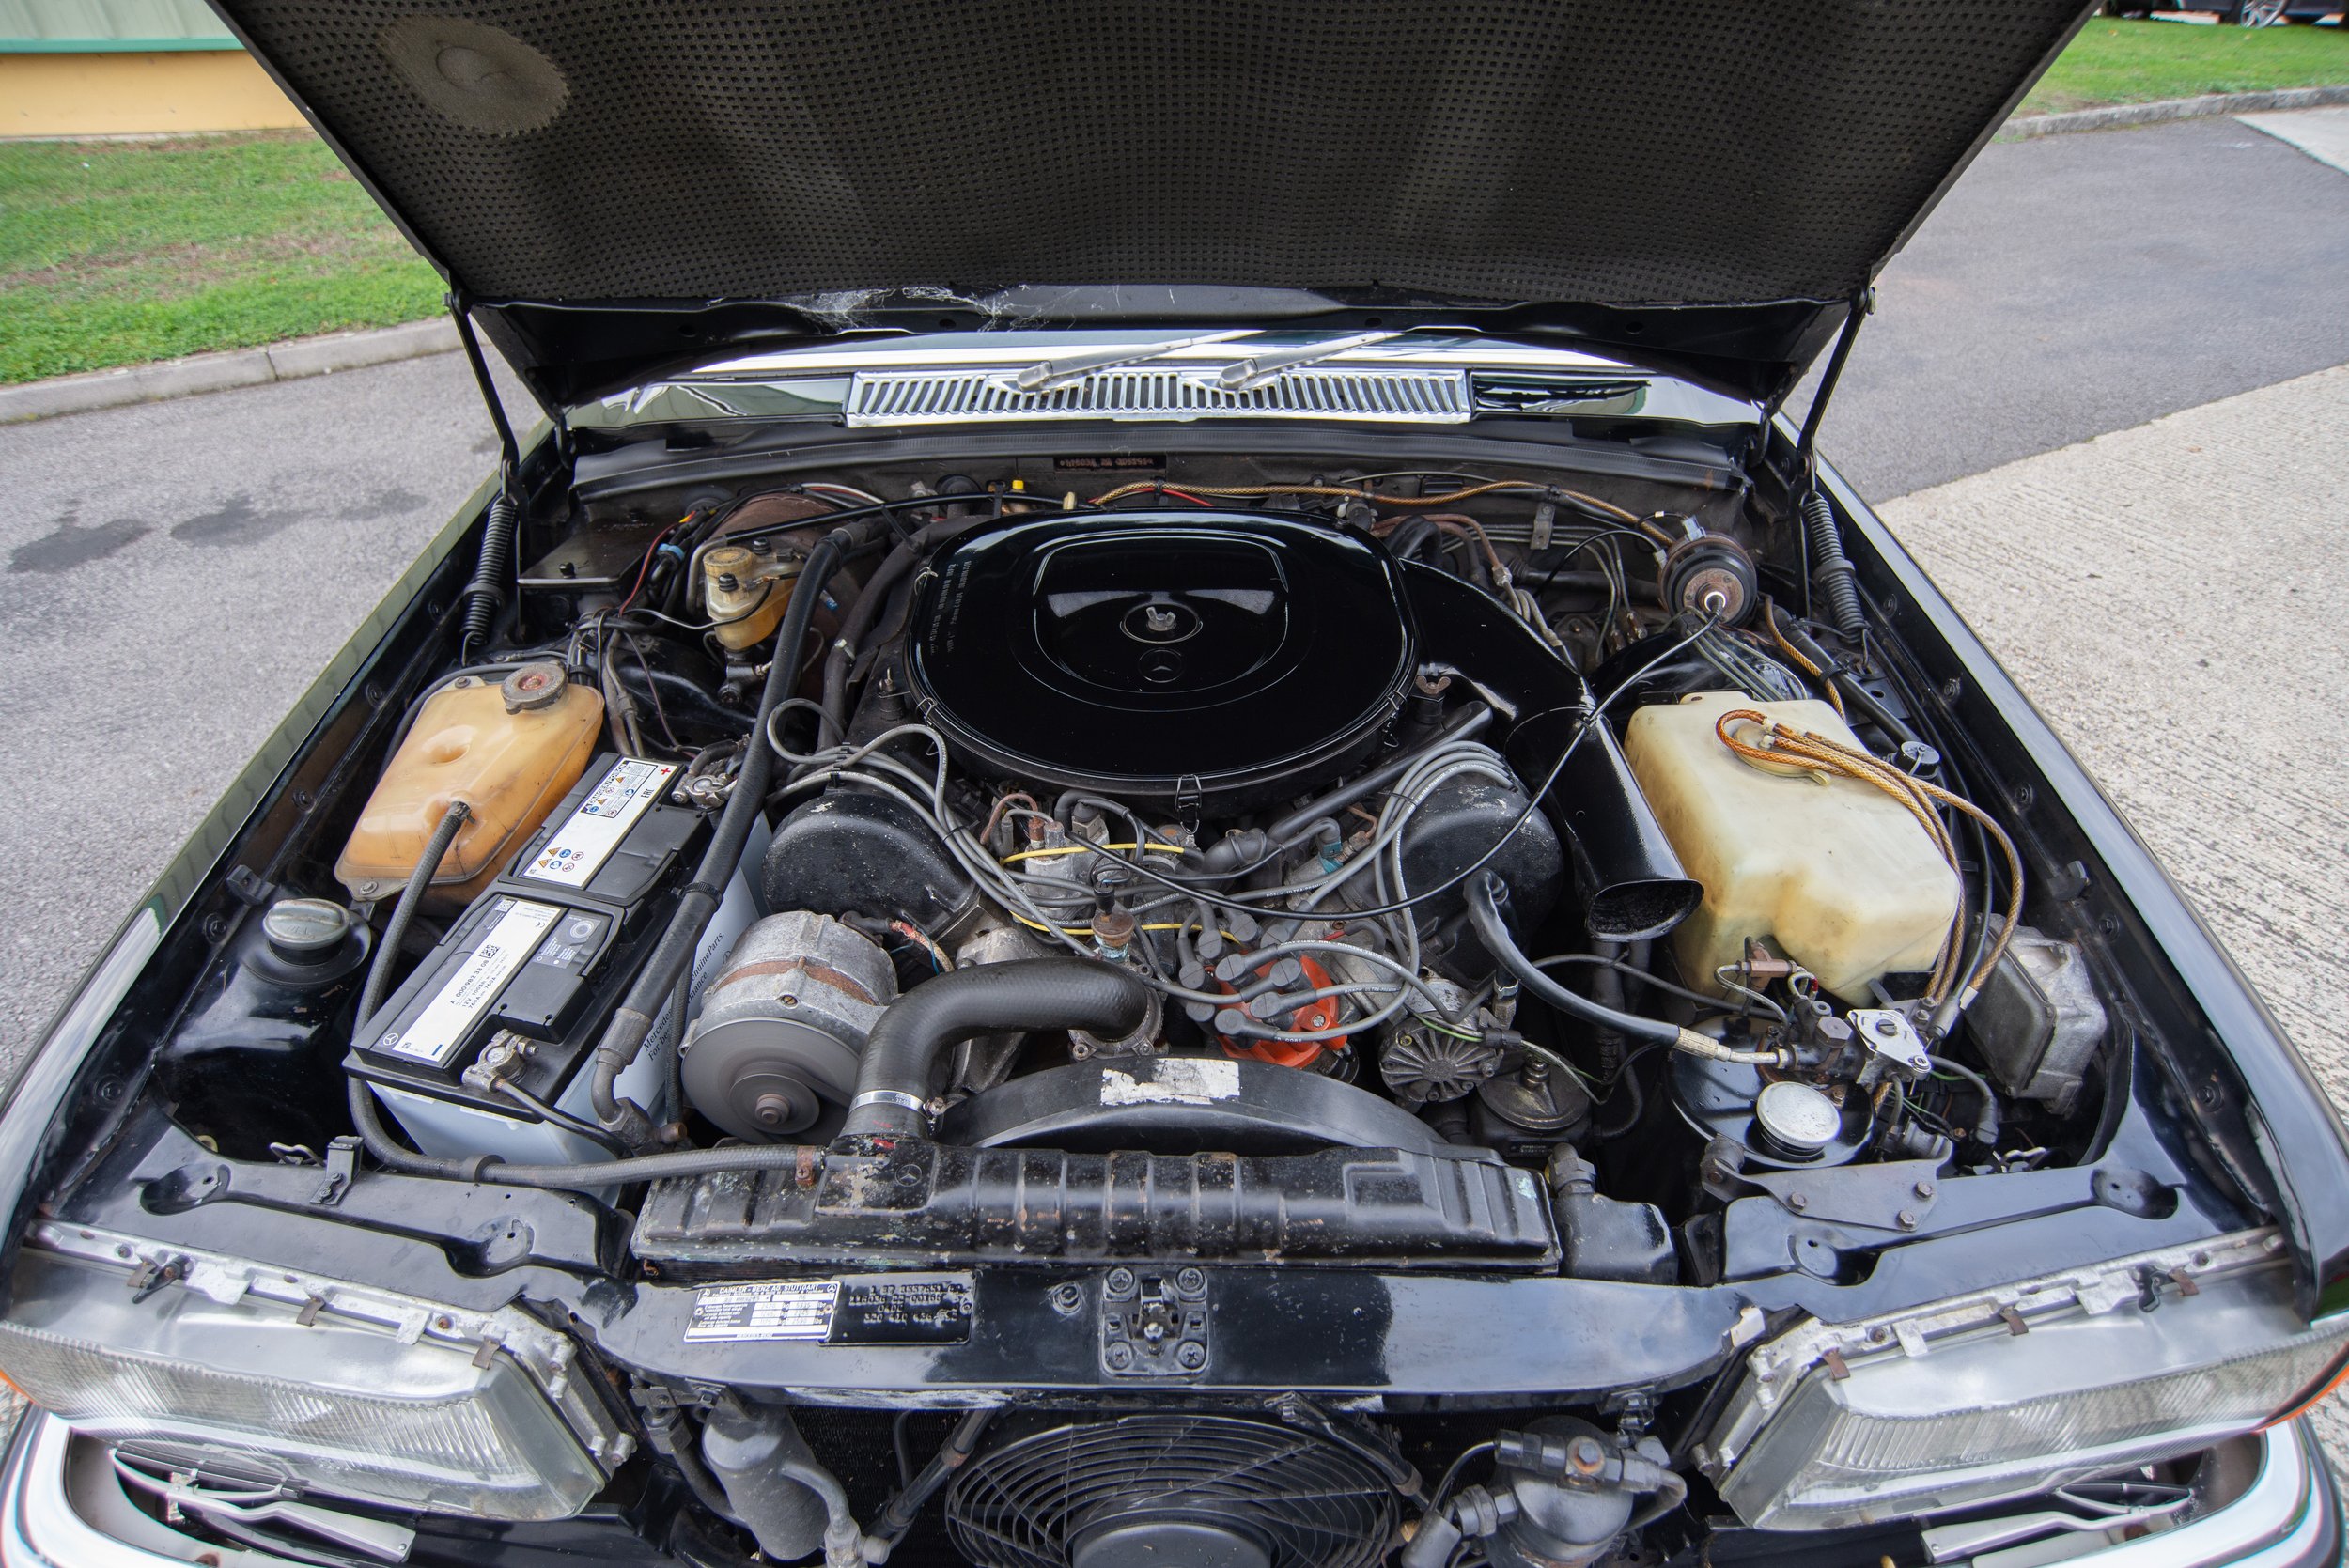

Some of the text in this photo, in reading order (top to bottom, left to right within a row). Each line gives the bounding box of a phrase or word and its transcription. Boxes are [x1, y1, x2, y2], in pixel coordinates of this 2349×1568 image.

[691, 932, 725, 982] enuineParts.
[1384, 957, 1403, 970] BOSCH
[456, 986, 467, 998] 000
[465, 975, 476, 986] 982
[648, 1045, 661, 1063] For
[719, 1286, 747, 1295] DAIMLER
[752, 1284, 770, 1293] BENZ
[784, 1283, 818, 1292] STUTTGART
